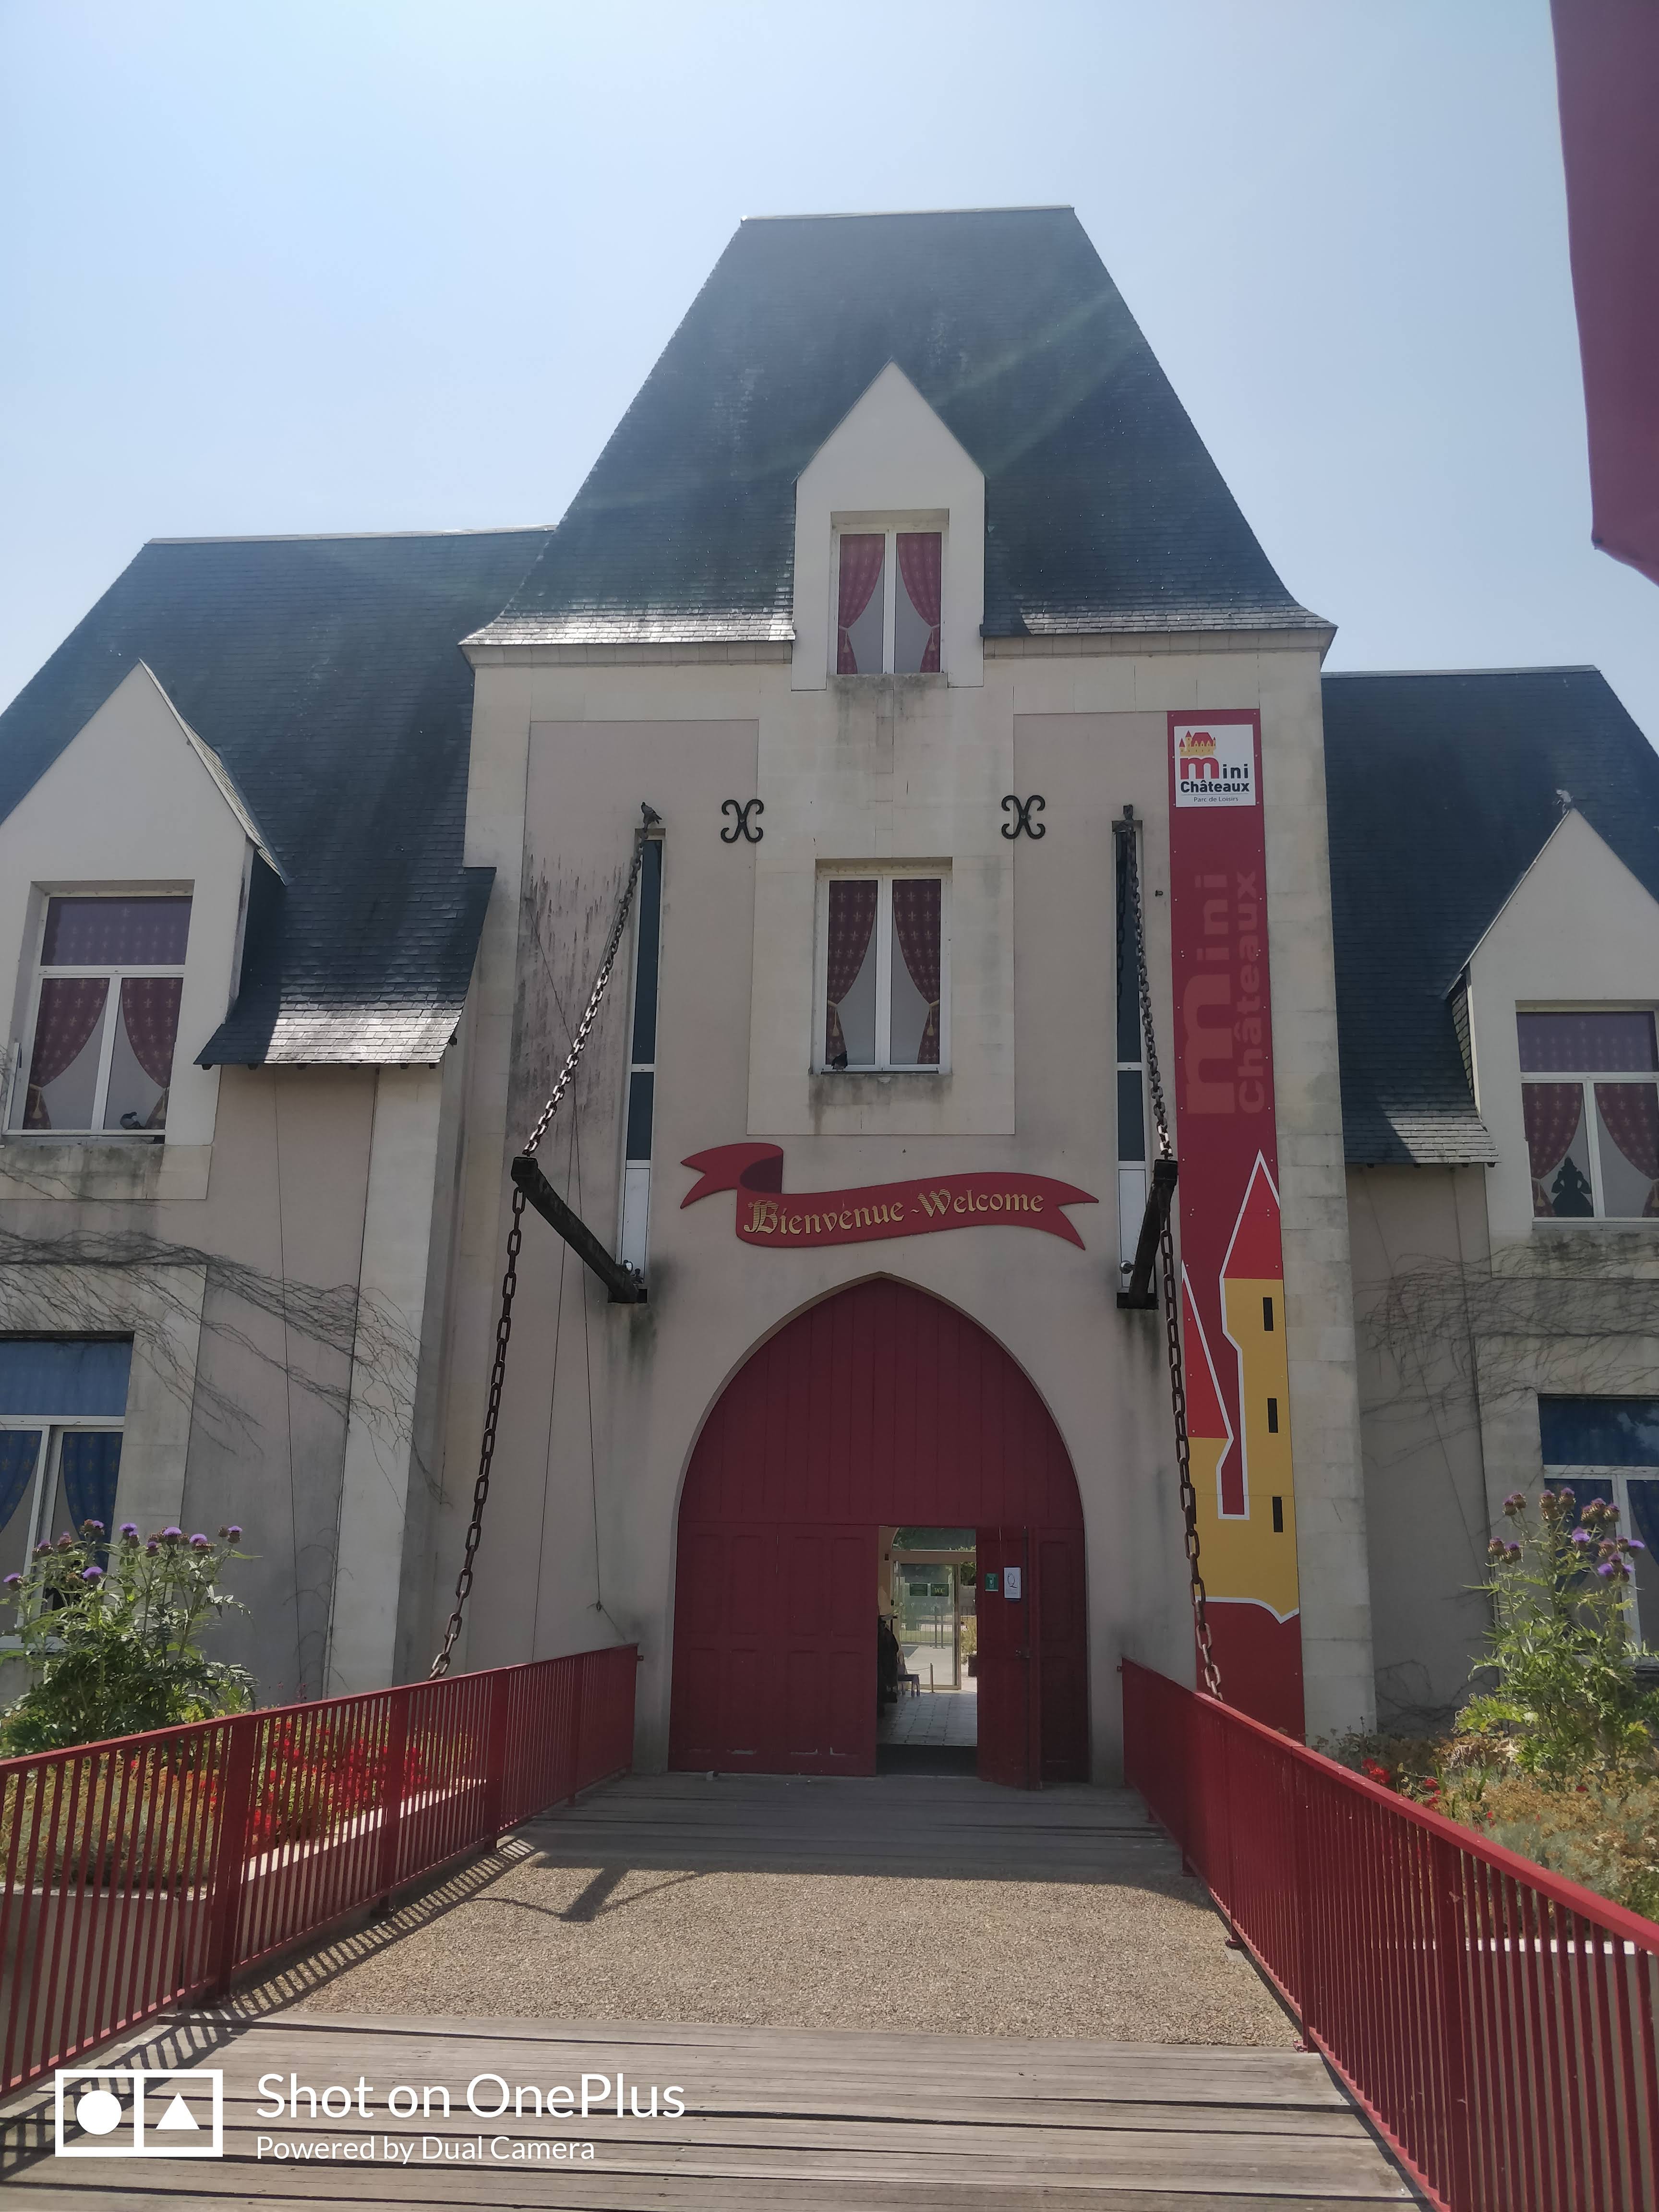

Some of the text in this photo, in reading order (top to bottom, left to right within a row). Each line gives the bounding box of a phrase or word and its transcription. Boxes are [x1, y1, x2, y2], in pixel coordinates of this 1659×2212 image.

[1180, 757, 1249, 780] mini
[1180, 780, 1250, 793] Châteaux
[1183, 874, 1236, 1114] mini
[1234, 871, 1265, 1113] Châteaux
[744, 1189, 1044, 1234] Bienvenue Welcome
